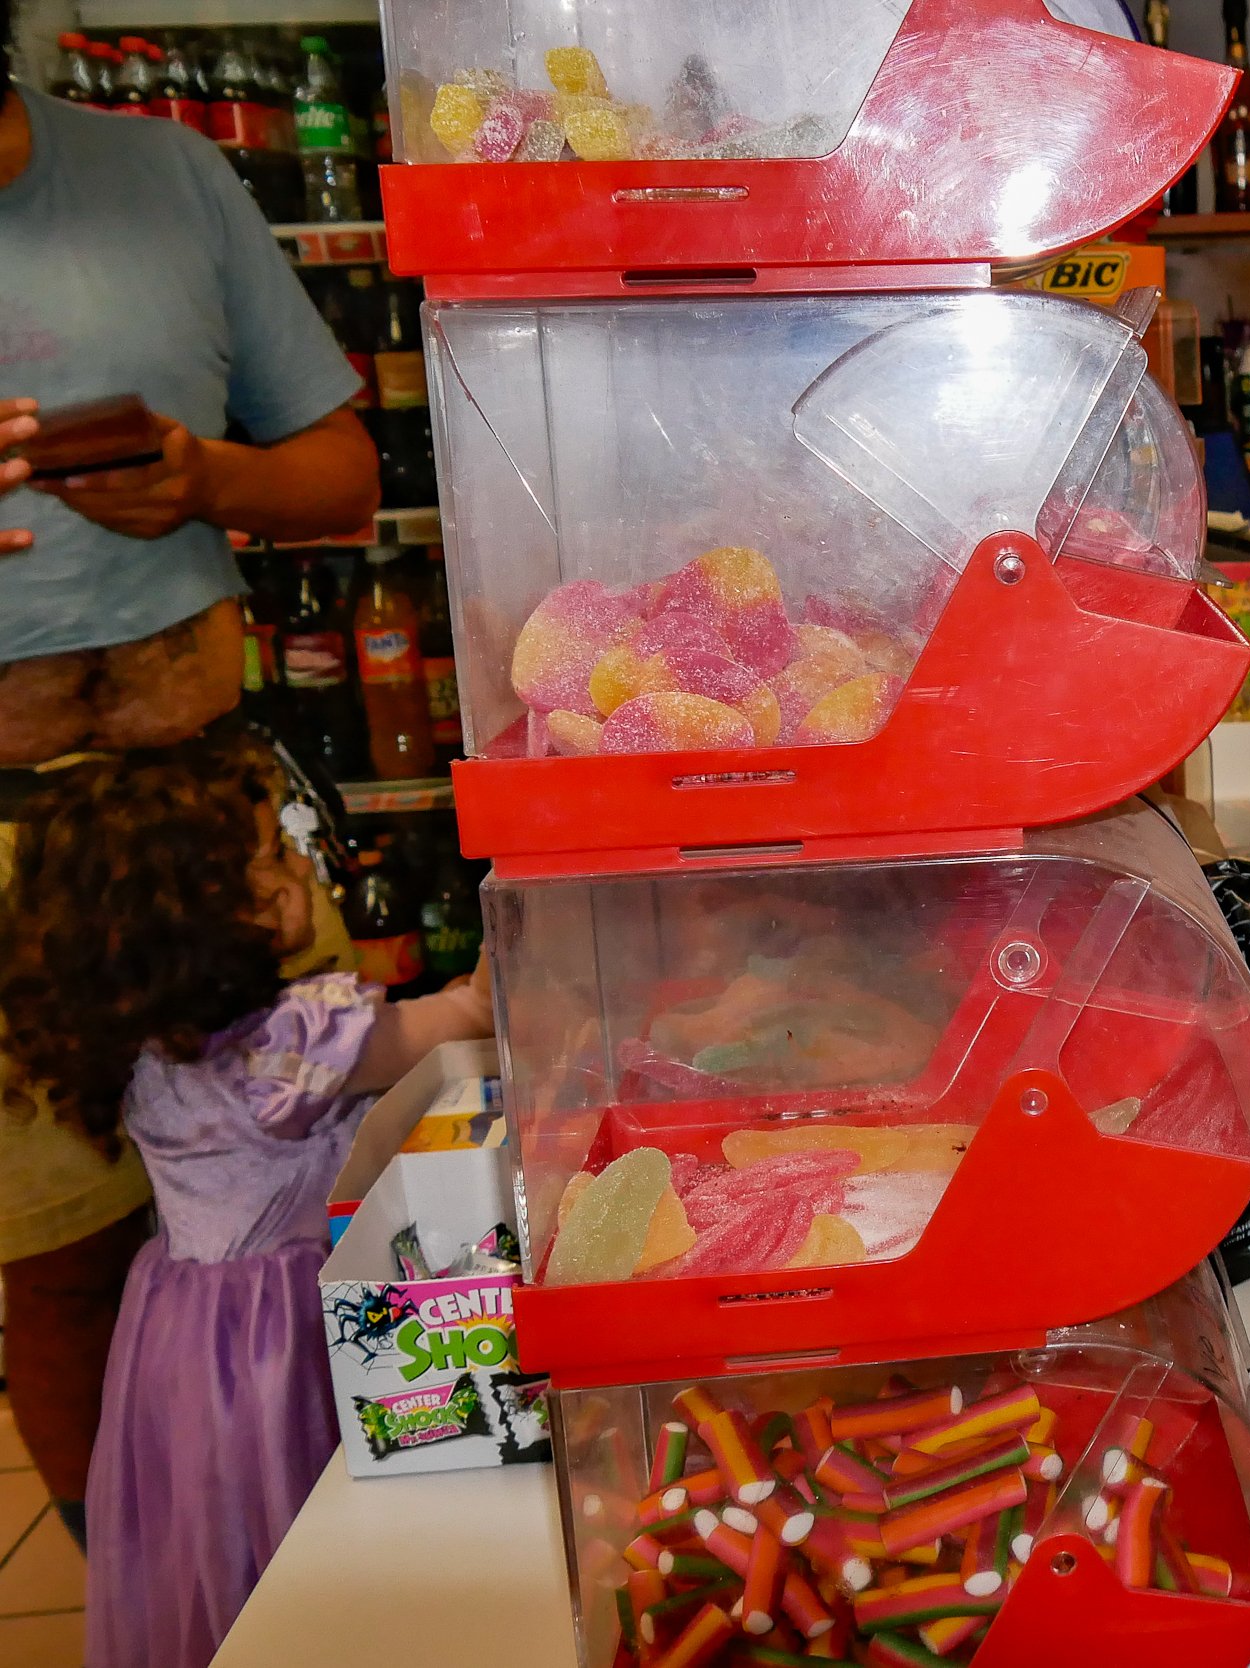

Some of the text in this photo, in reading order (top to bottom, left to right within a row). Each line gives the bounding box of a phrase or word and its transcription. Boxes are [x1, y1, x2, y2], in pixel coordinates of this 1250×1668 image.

[1049, 262, 1120, 288] BIC
[391, 1393, 442, 1414] CENTER
[384, 1402, 466, 1438] SHOCK
